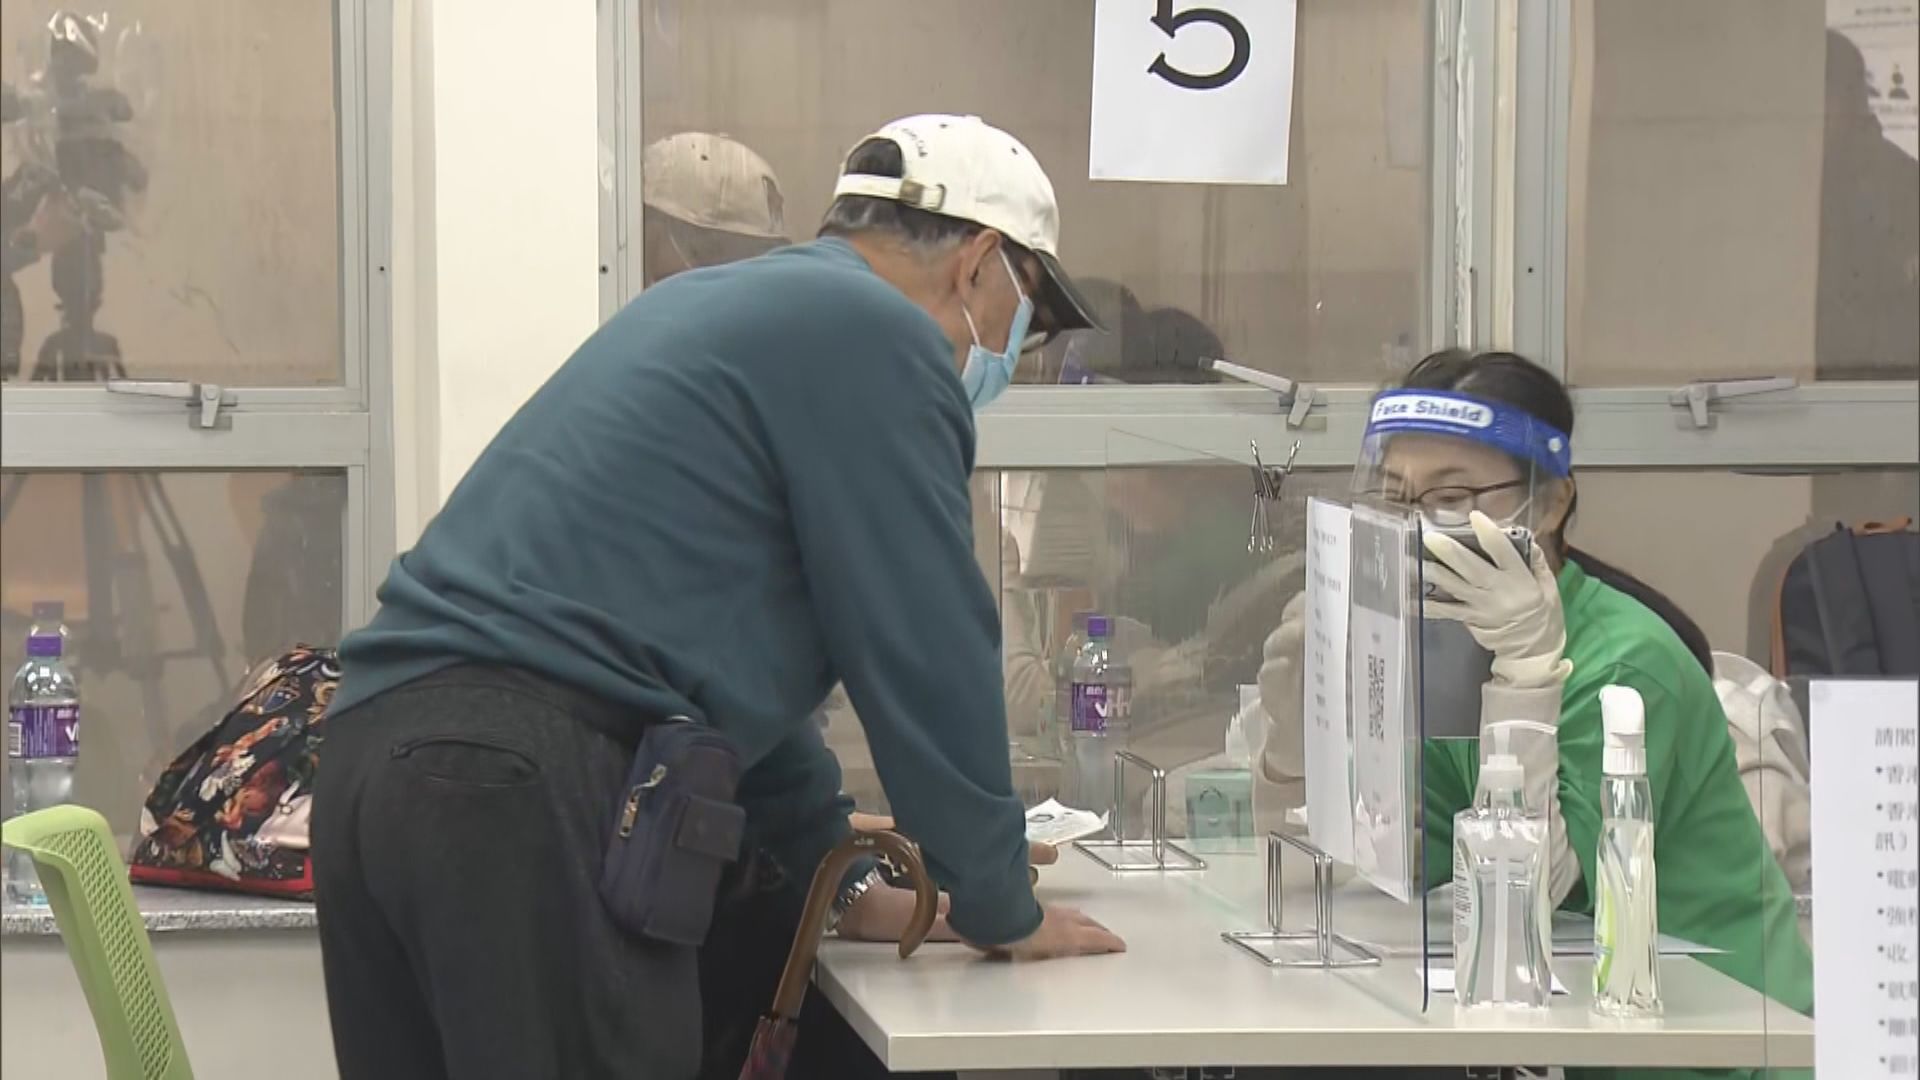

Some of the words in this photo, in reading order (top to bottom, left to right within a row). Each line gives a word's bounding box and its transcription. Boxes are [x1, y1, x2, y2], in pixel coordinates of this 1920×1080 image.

[1147, 0, 1251, 90] 5
[1376, 402, 1408, 416] Face
[1415, 400, 1482, 421] Shield
